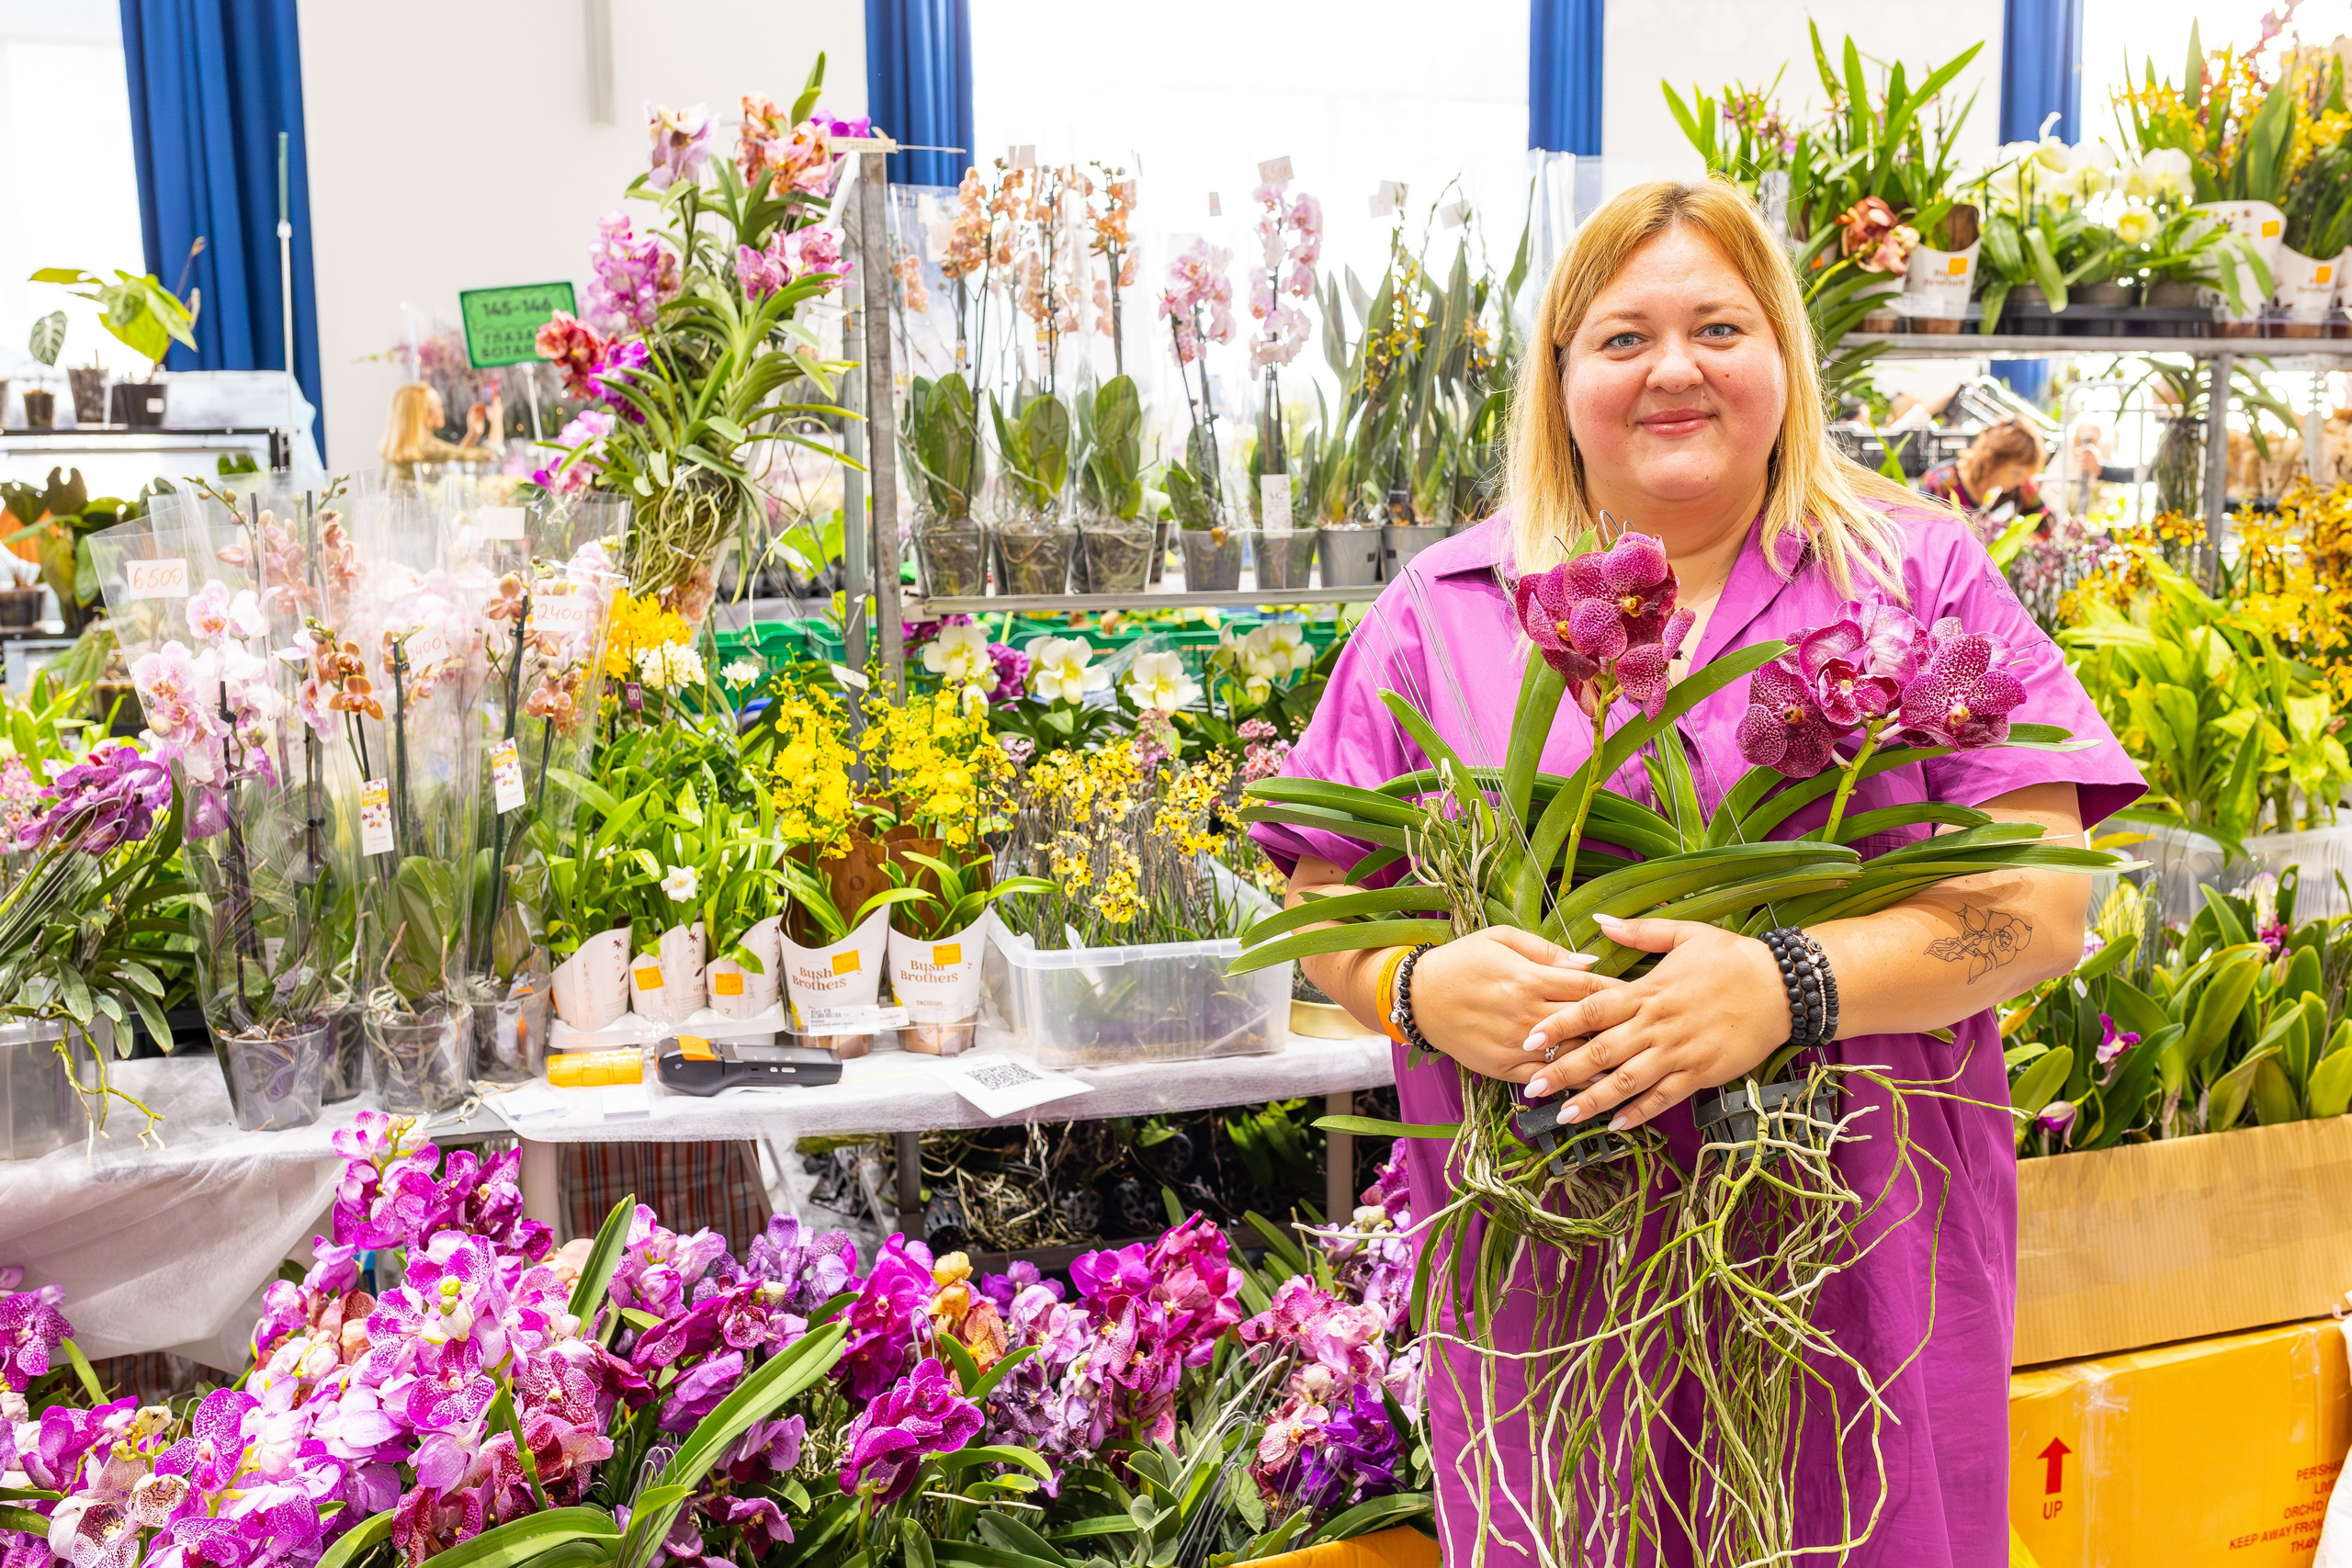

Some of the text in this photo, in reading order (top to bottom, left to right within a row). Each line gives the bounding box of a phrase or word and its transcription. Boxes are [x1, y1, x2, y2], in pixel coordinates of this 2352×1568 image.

[133, 566, 184, 591] 6500
[537, 603, 582, 622] 2400
[799, 966, 832, 980] Bush
[900, 969, 959, 984] Brothers
[792, 975, 847, 991] Brothers
[2042, 1500, 2064, 1520] UP
[2283, 1500, 2324, 1518] ORCHID
[2229, 1533, 2258, 1550] KEEP
[2261, 1526, 2293, 1542] AWAY
